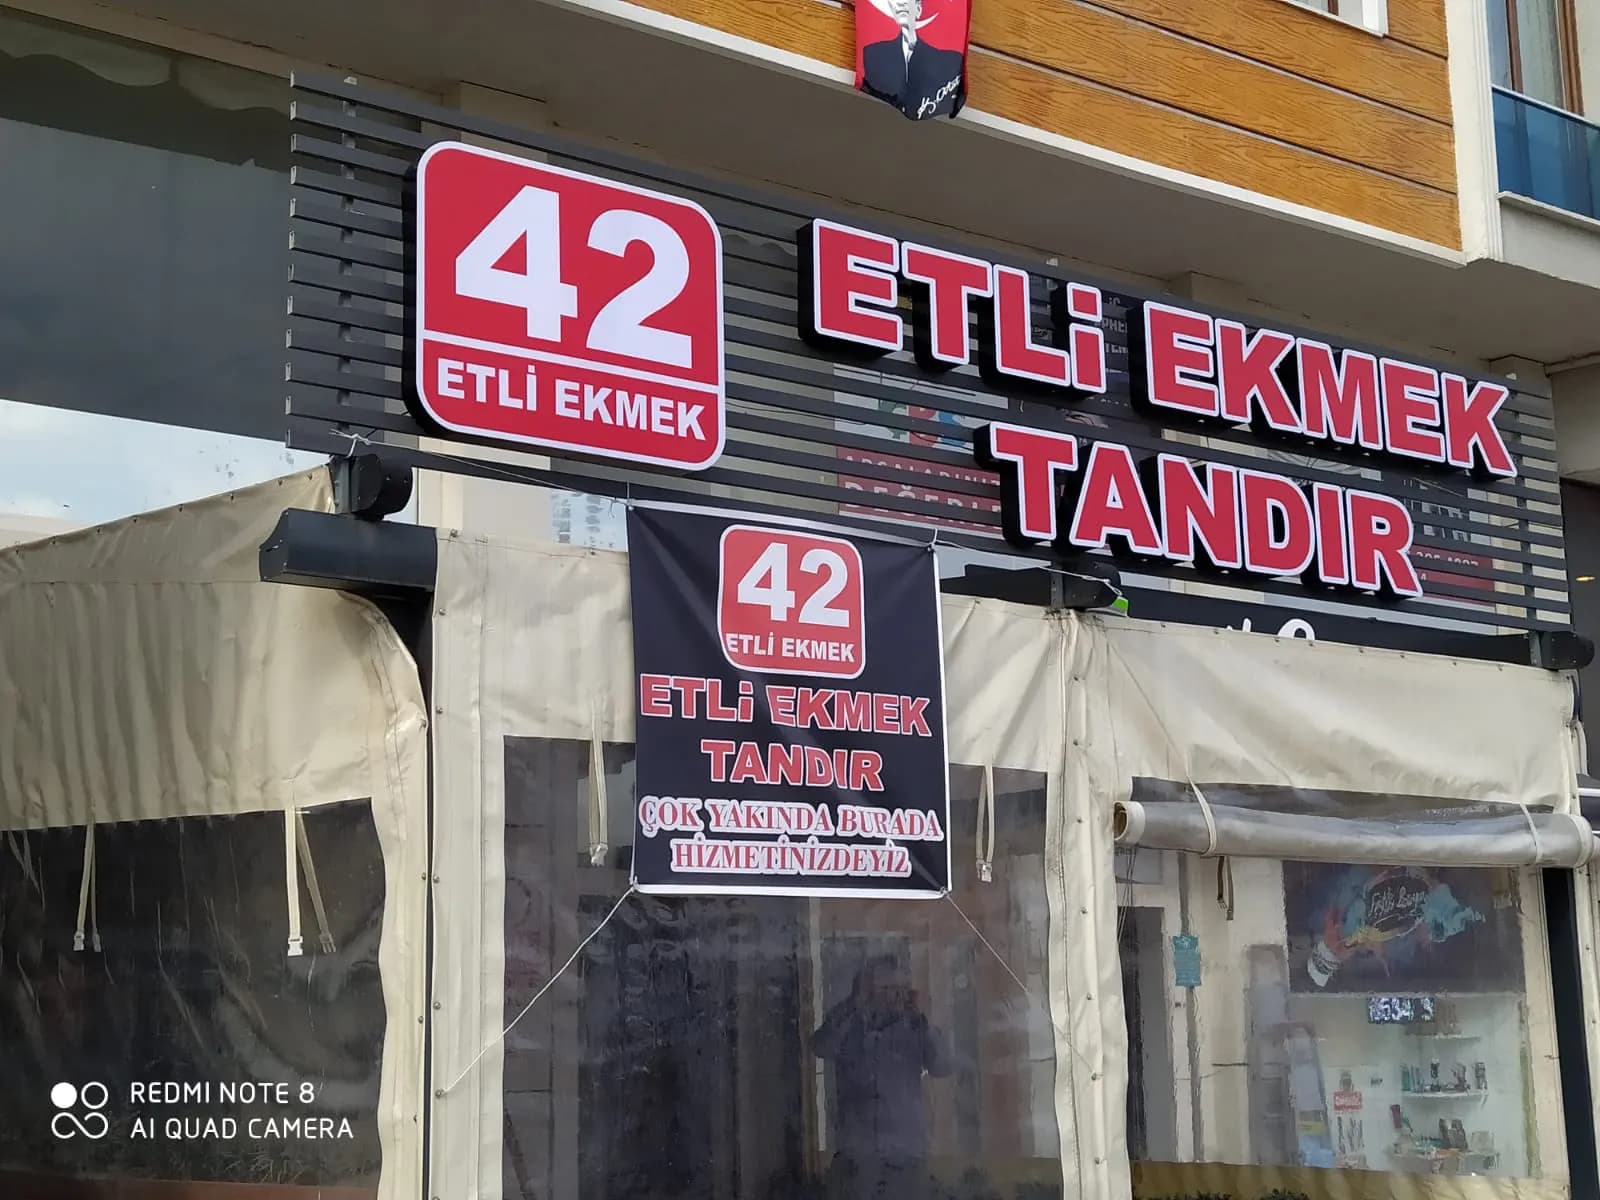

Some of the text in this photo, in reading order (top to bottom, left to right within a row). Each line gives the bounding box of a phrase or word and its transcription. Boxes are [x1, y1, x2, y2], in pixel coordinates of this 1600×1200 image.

[455, 185, 693, 369] 42
[437, 357, 706, 442] ETLİ EKMEK
[1143, 301, 1517, 478] EKMEK
[990, 422, 1424, 598] TANDIR
[737, 542, 849, 627] 42
[726, 632, 855, 664] ETLİ EKMEK
[765, 685, 931, 738] EKMEK
[701, 739, 884, 791] TANDIR
[637, 797, 945, 842] ÇOK YAKINDA BURADA
